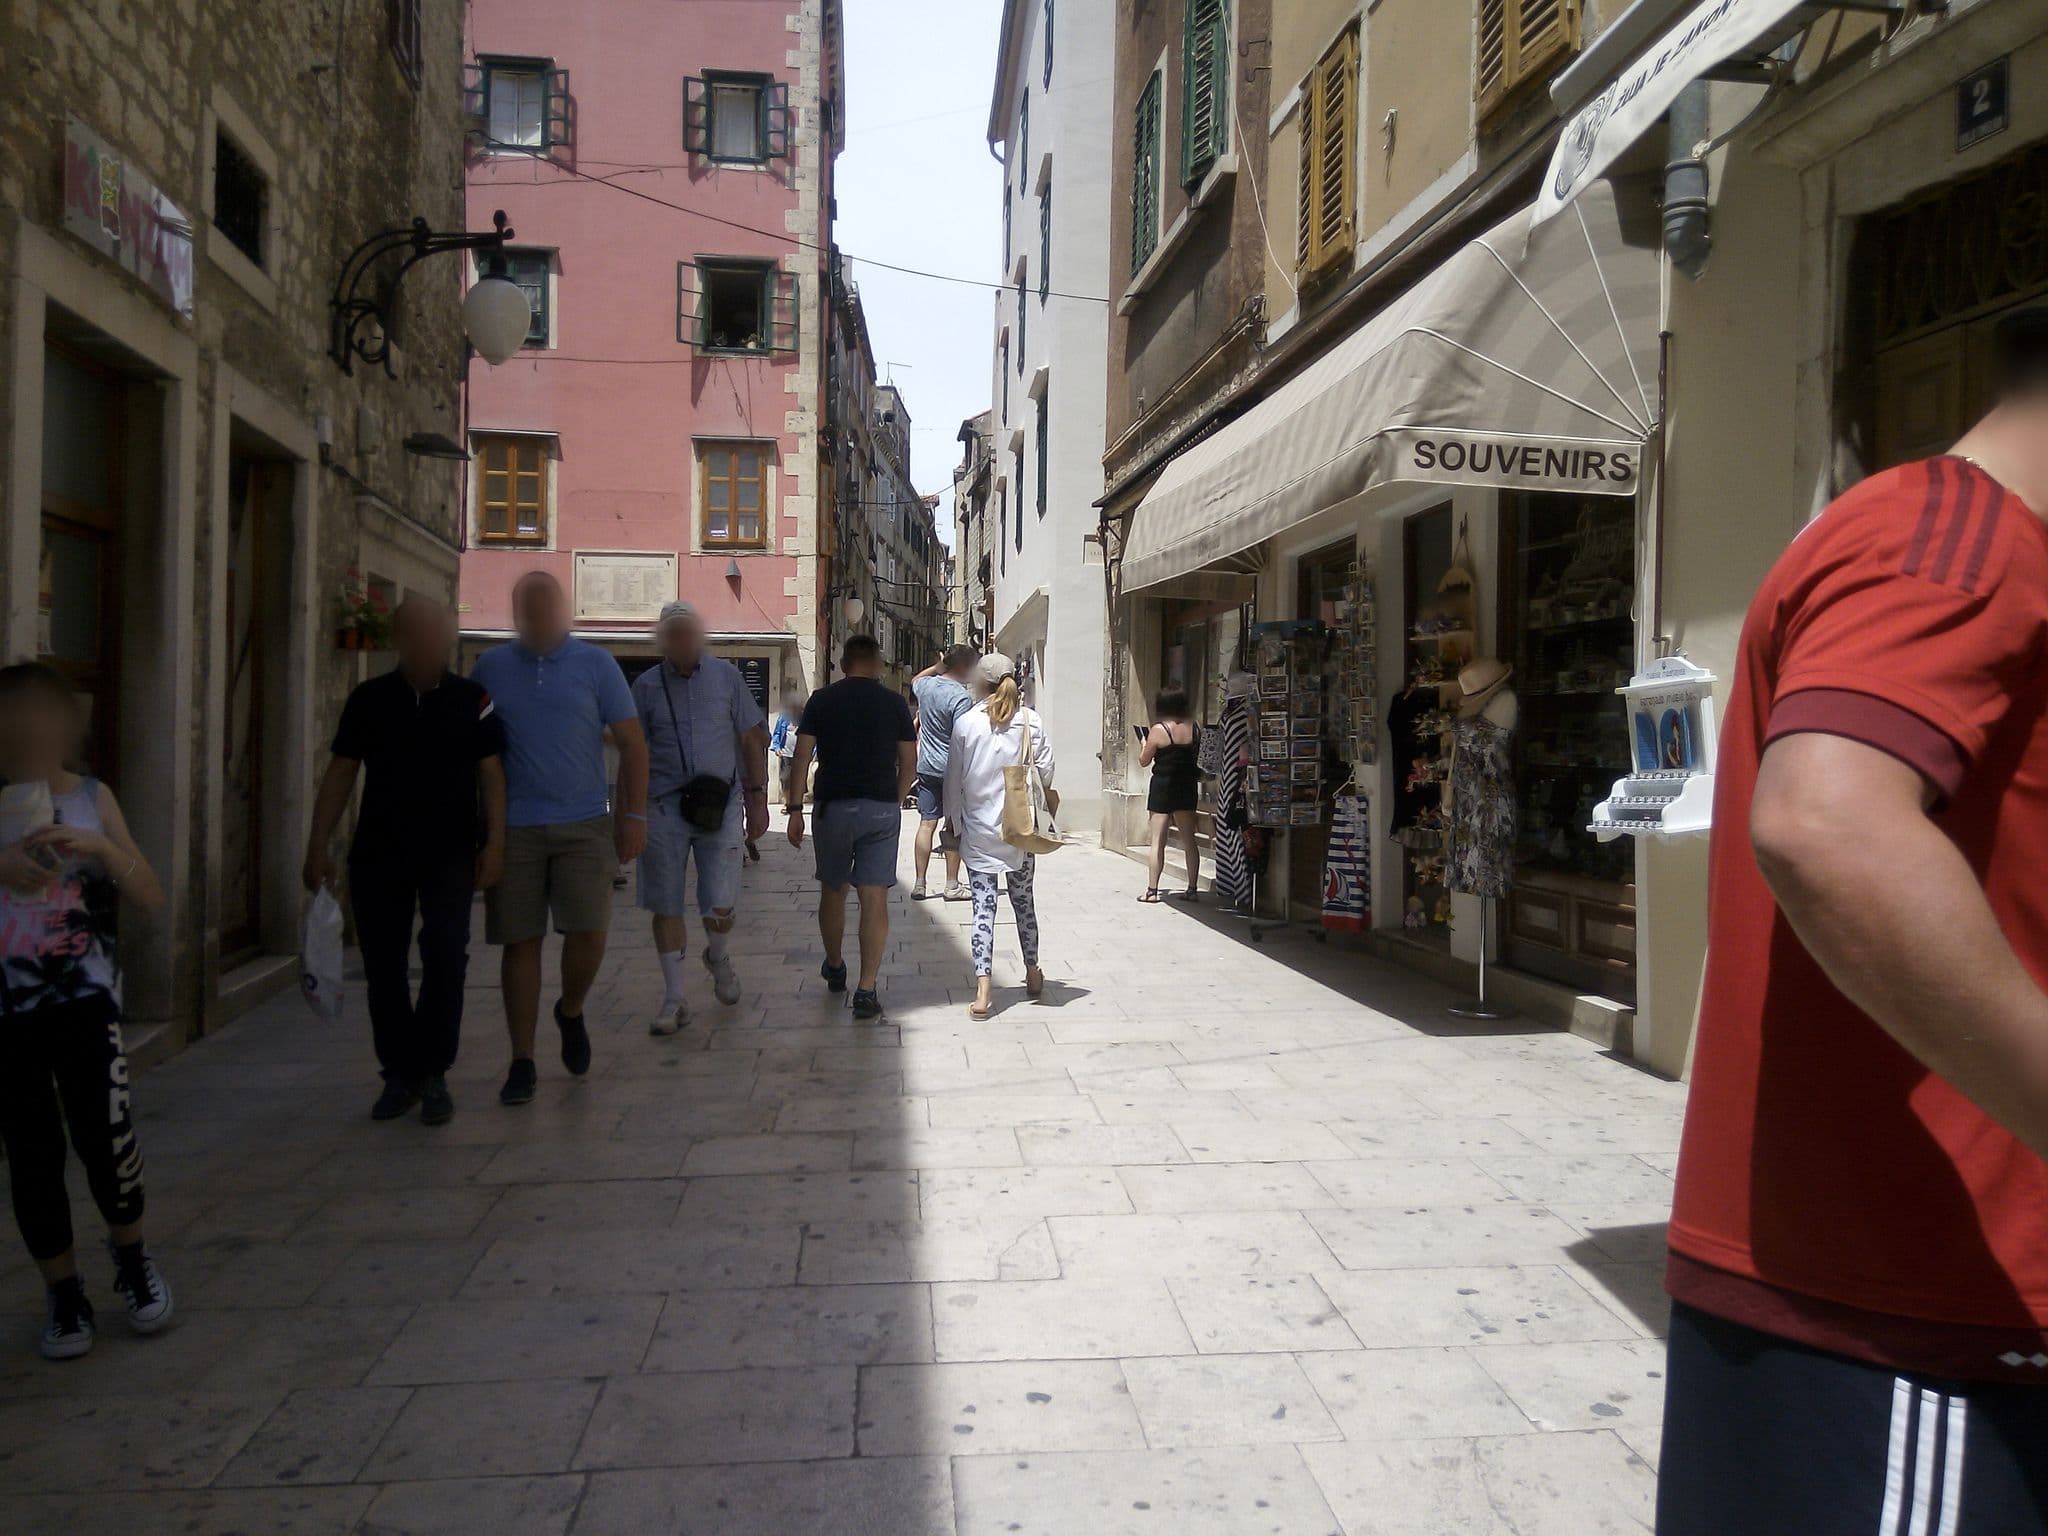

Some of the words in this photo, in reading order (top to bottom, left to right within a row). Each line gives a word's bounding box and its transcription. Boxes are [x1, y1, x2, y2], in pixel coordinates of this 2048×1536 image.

[1648, 48, 1672, 83] JE
[1972, 79, 1991, 117] 2
[1413, 440, 1632, 482] SOUVENIRS
